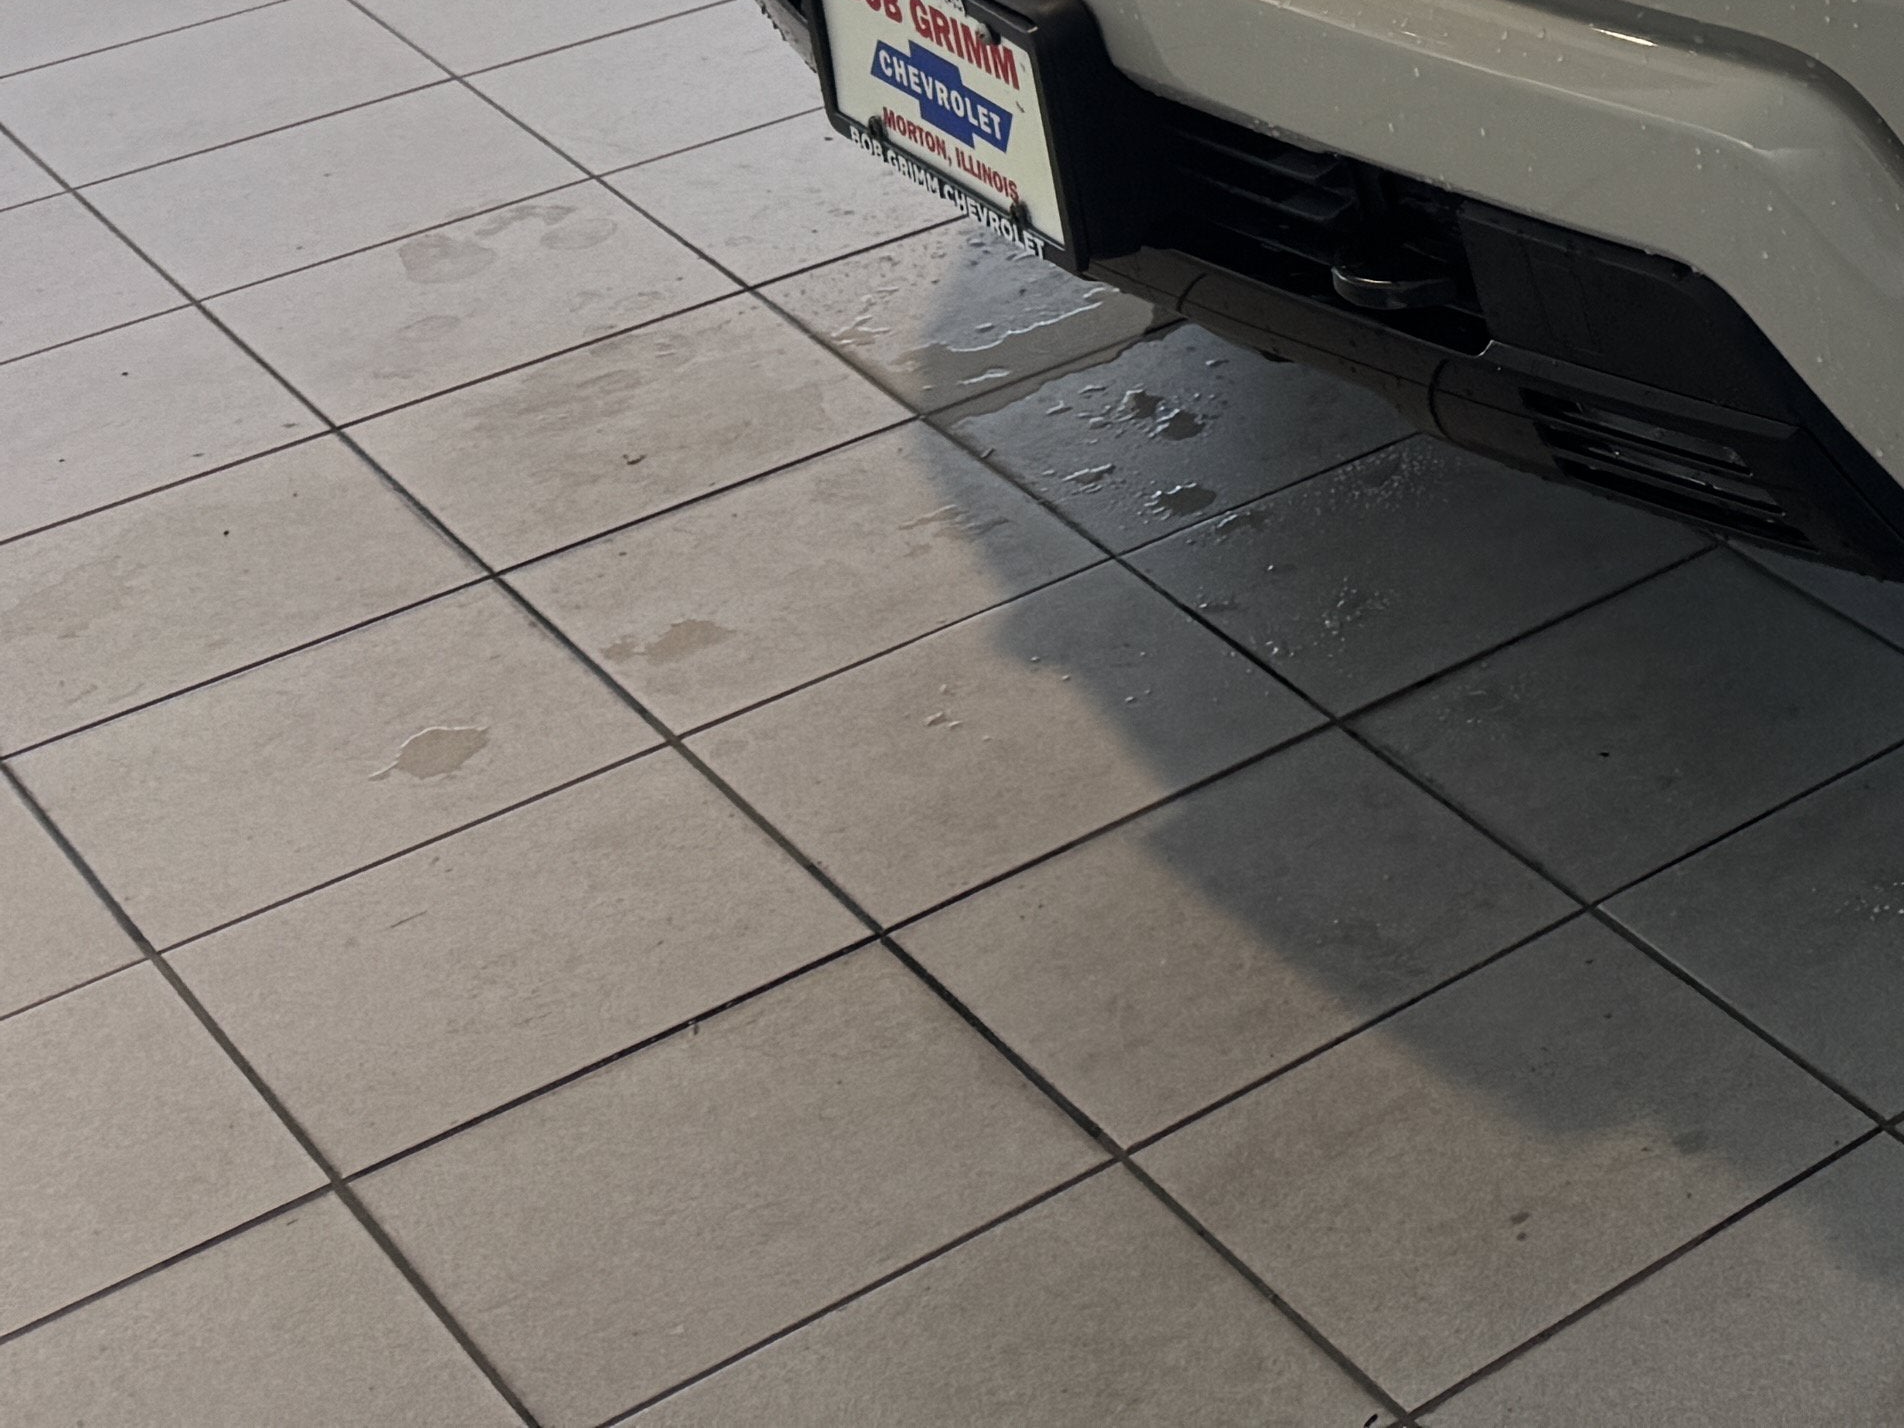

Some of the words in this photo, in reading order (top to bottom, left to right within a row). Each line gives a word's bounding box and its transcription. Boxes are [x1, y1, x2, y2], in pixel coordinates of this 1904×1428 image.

[878, 49, 1002, 140] CHEVROLET
[850, 126, 883, 164] BOB
[886, 152, 941, 198] GRIMM
[943, 186, 1046, 260] CHEVROLET
[955, 146, 1019, 204] ILLINOIS
